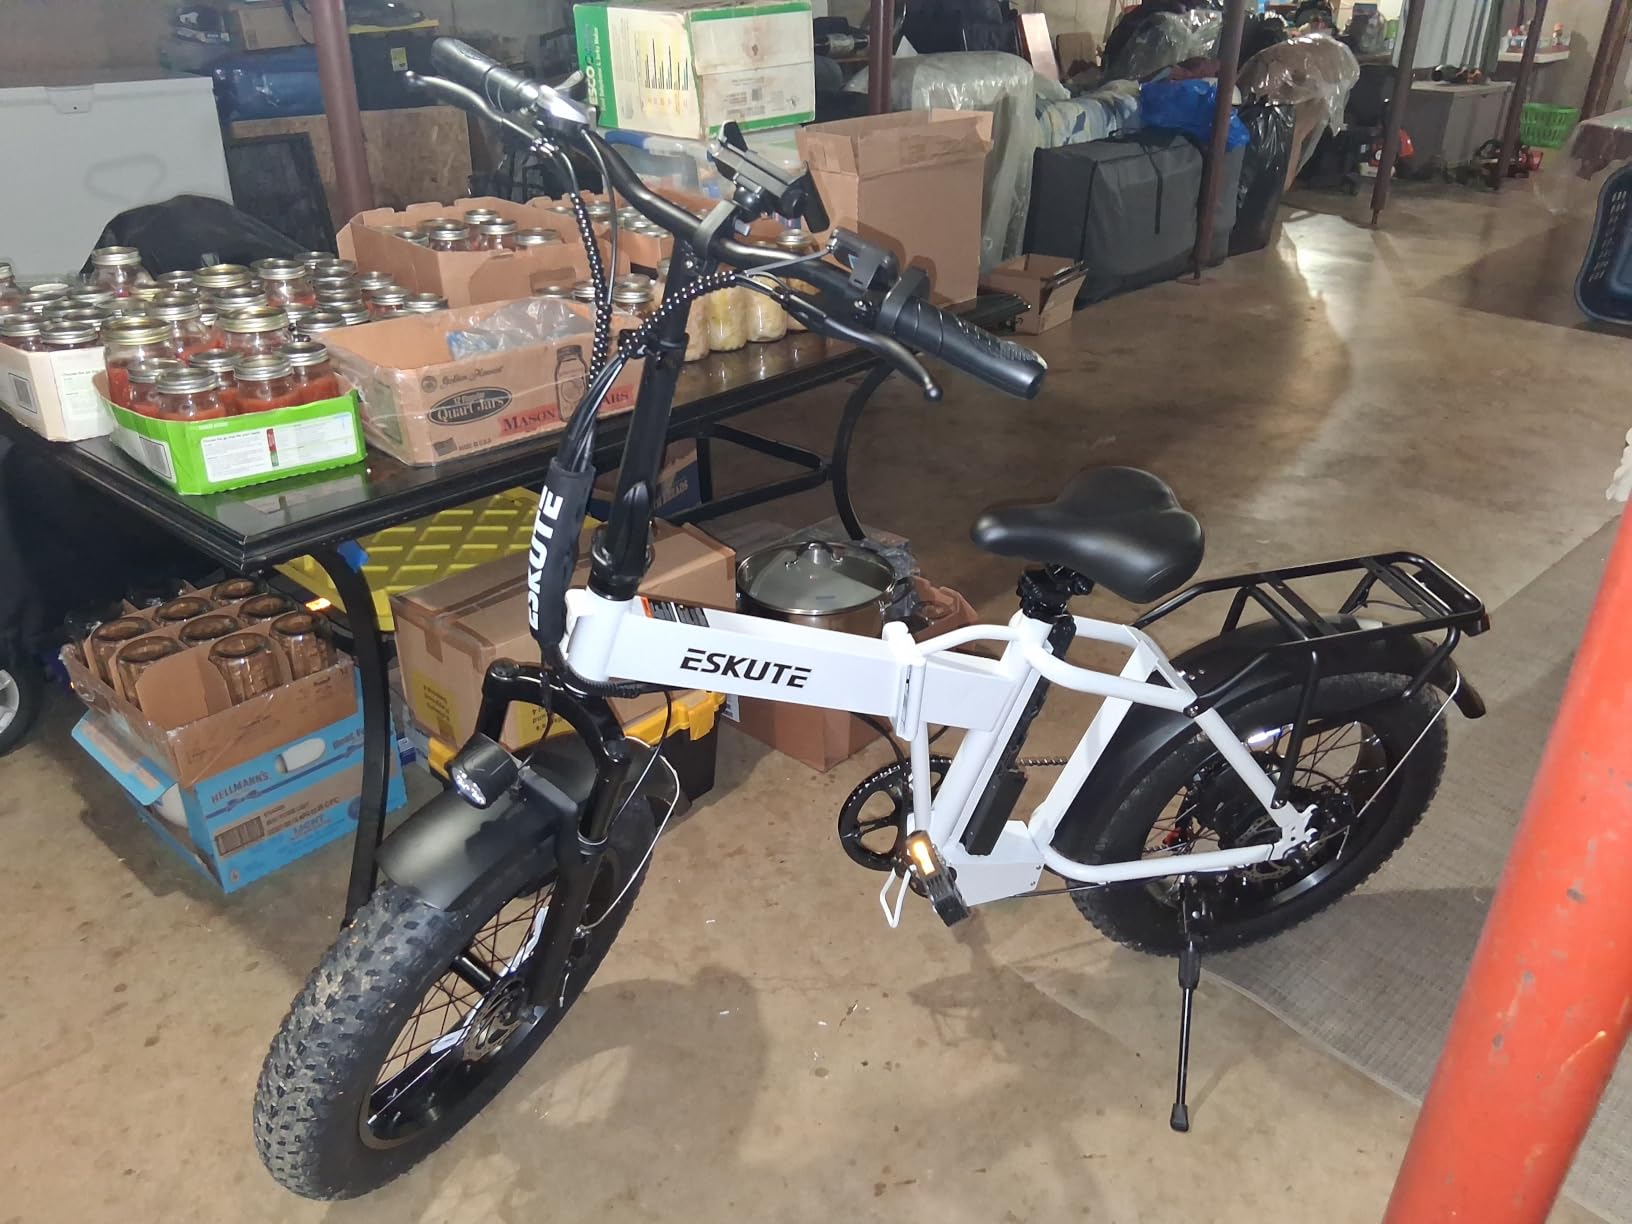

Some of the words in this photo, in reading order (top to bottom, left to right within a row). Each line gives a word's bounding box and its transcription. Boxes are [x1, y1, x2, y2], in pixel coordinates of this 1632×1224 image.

[586, 66, 598, 105] ESCO
[437, 401, 474, 422] Quart
[477, 399, 504, 412] Jars
[503, 408, 556, 432] MASON
[602, 391, 629, 405] ARS
[528, 485, 564, 631] ESKUTE
[680, 648, 812, 688] ESKUTE
